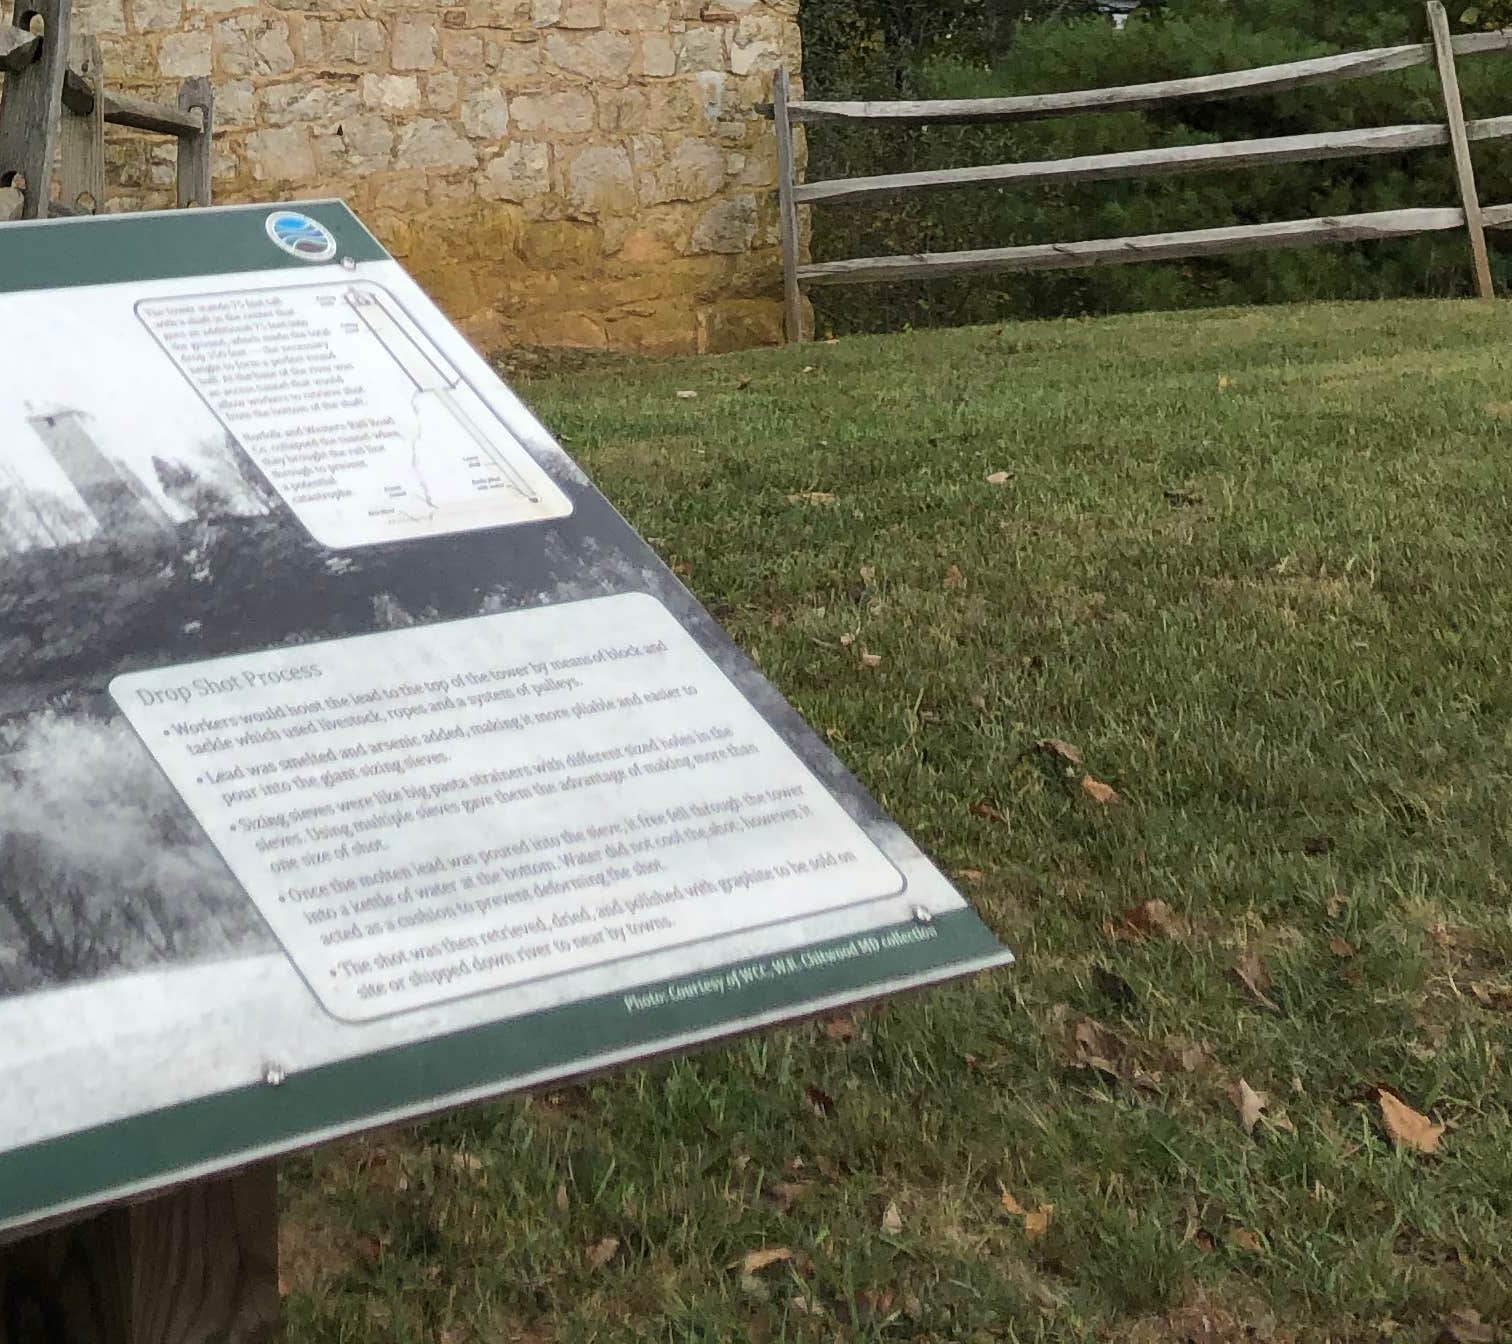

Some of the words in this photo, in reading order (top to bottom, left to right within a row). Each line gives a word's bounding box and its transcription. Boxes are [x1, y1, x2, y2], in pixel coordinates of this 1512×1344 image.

[134, 685, 196, 706] Drop
[191, 674, 244, 697] Shot
[241, 664, 323, 688] Process
